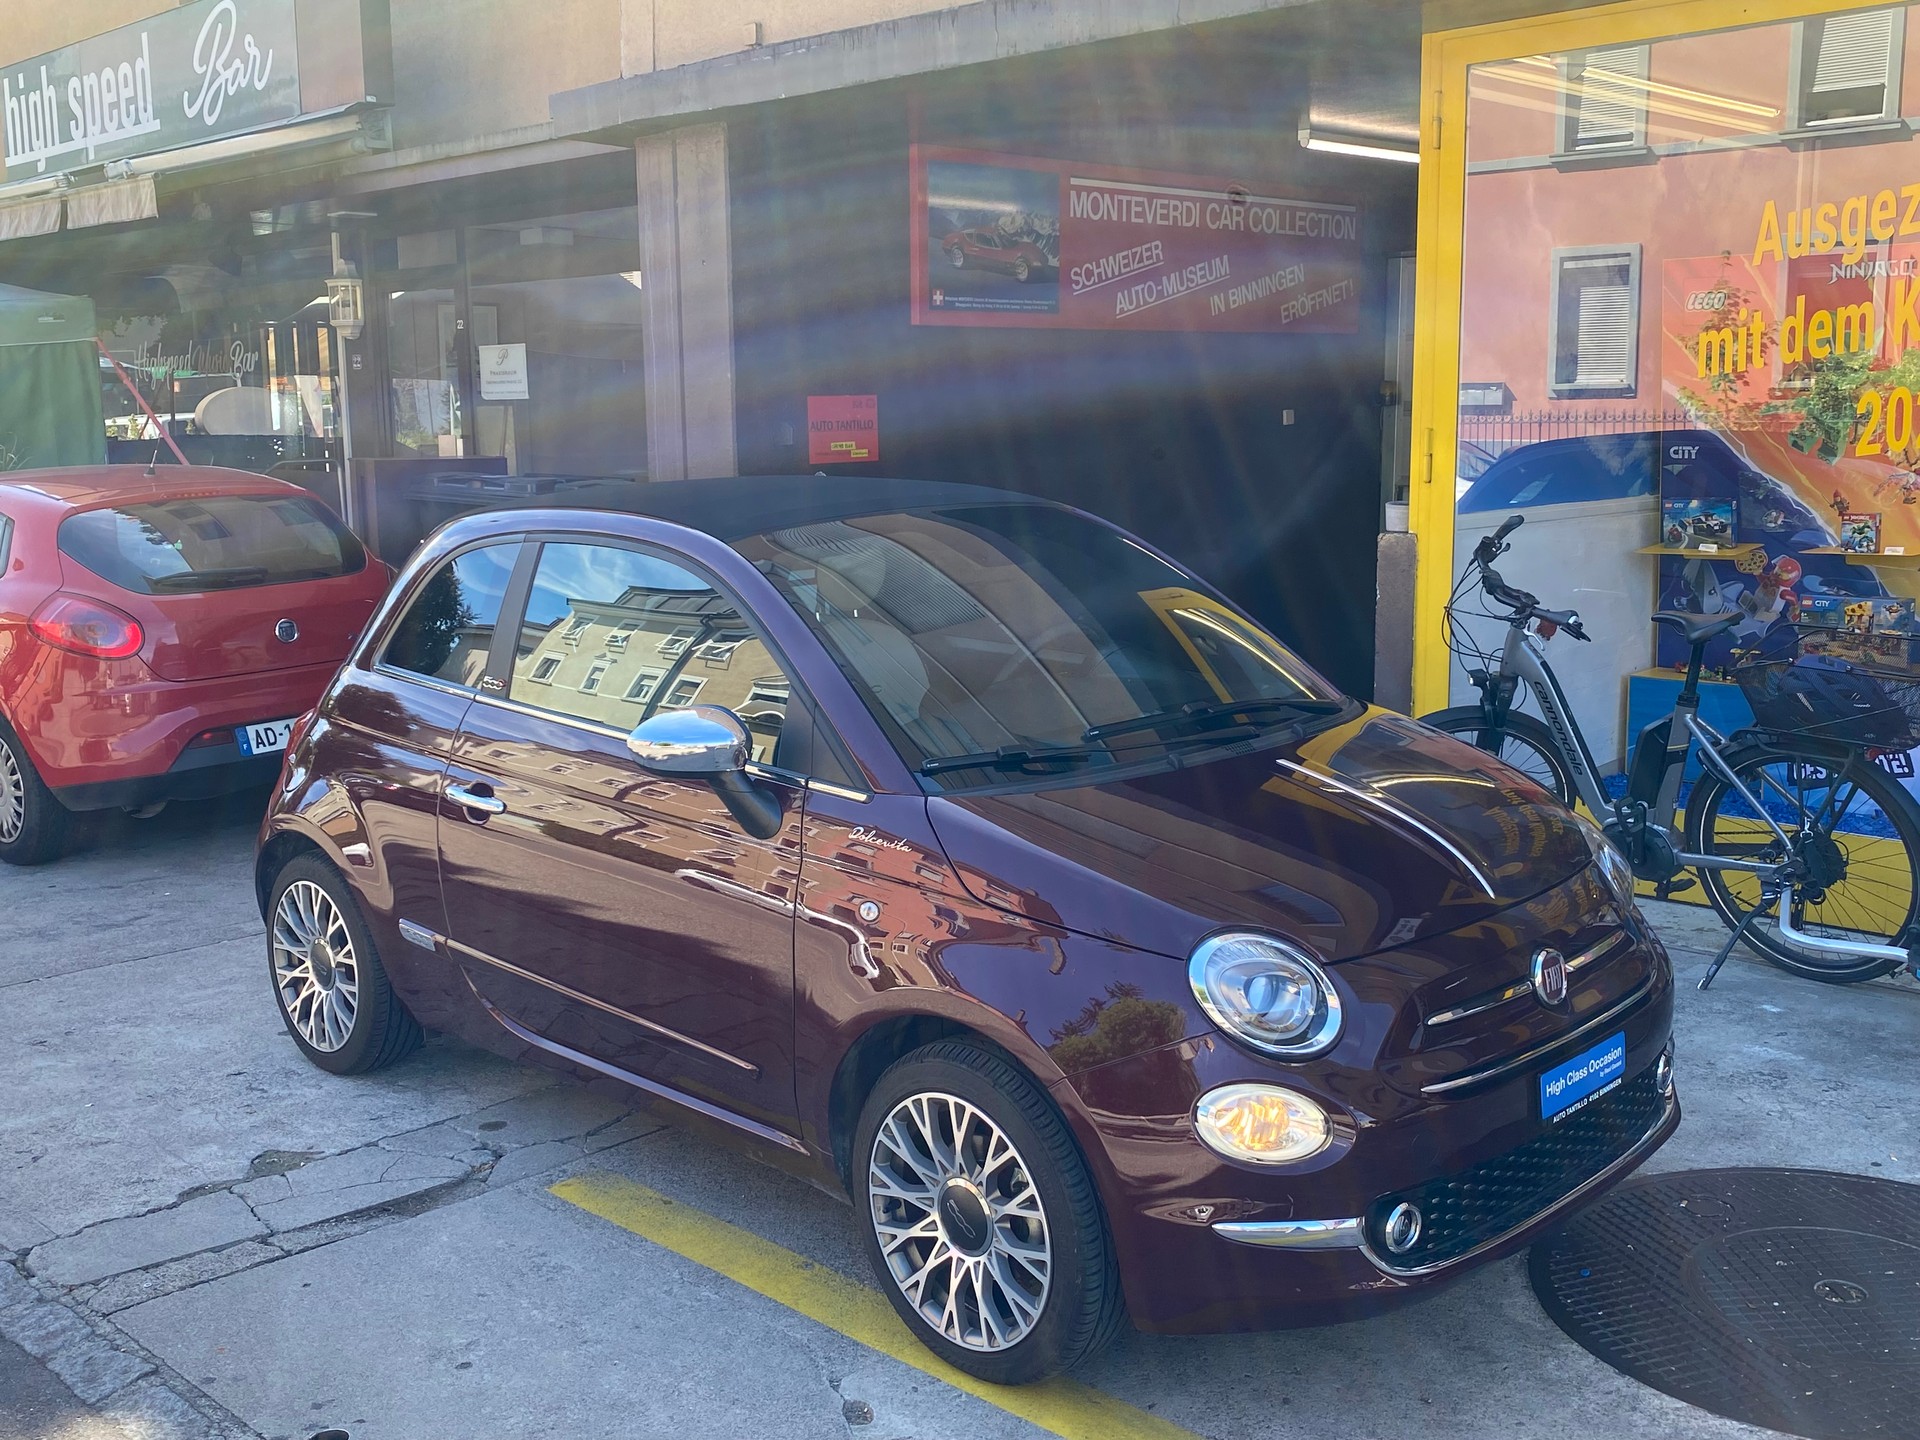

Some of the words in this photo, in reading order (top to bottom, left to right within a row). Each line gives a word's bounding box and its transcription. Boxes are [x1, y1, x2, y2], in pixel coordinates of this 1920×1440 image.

[3, 64, 59, 172] high
[67, 31, 158, 160] speed
[182, 0, 273, 126] Bar
[1069, 190, 1200, 228] MONTEVERDI
[1206, 203, 1245, 231] CAR
[1249, 207, 1356, 240] COLLECTION
[1070, 240, 1163, 290] SCHWEIZER
[1115, 254, 1230, 315] AUTO-MUSEUM
[1210, 295, 1226, 316] IN
[1229, 263, 1306, 311] BINNINGEN
[456, 320, 464, 329] 22
[1686, 291, 1726, 311] LEGO
[1697, 307, 1766, 378] mit
[1780, 294, 1875, 364] dem
[135, 340, 192, 390] Highspeed
[229, 340, 258, 380] Bar
[810, 420, 833, 431] AUTO
[835, 419, 874, 431] TANTILLO
[1856, 386, 1920, 457] 20
[1669, 445, 1700, 459] CITY
[1534, 681, 1583, 776] cannondale
[848, 826, 912, 852] Dolcevita
[1543, 963, 1562, 993] FIAT
[1546, 1077, 1566, 1097] High
[1567, 1066, 1588, 1085] Class
[1589, 1046, 1622, 1073] Occasion
[1553, 1111, 1566, 1123] AUTO
[1566, 1098, 1588, 1115] TANTILLO
[1600, 1077, 1622, 1096] BINNINGEN
